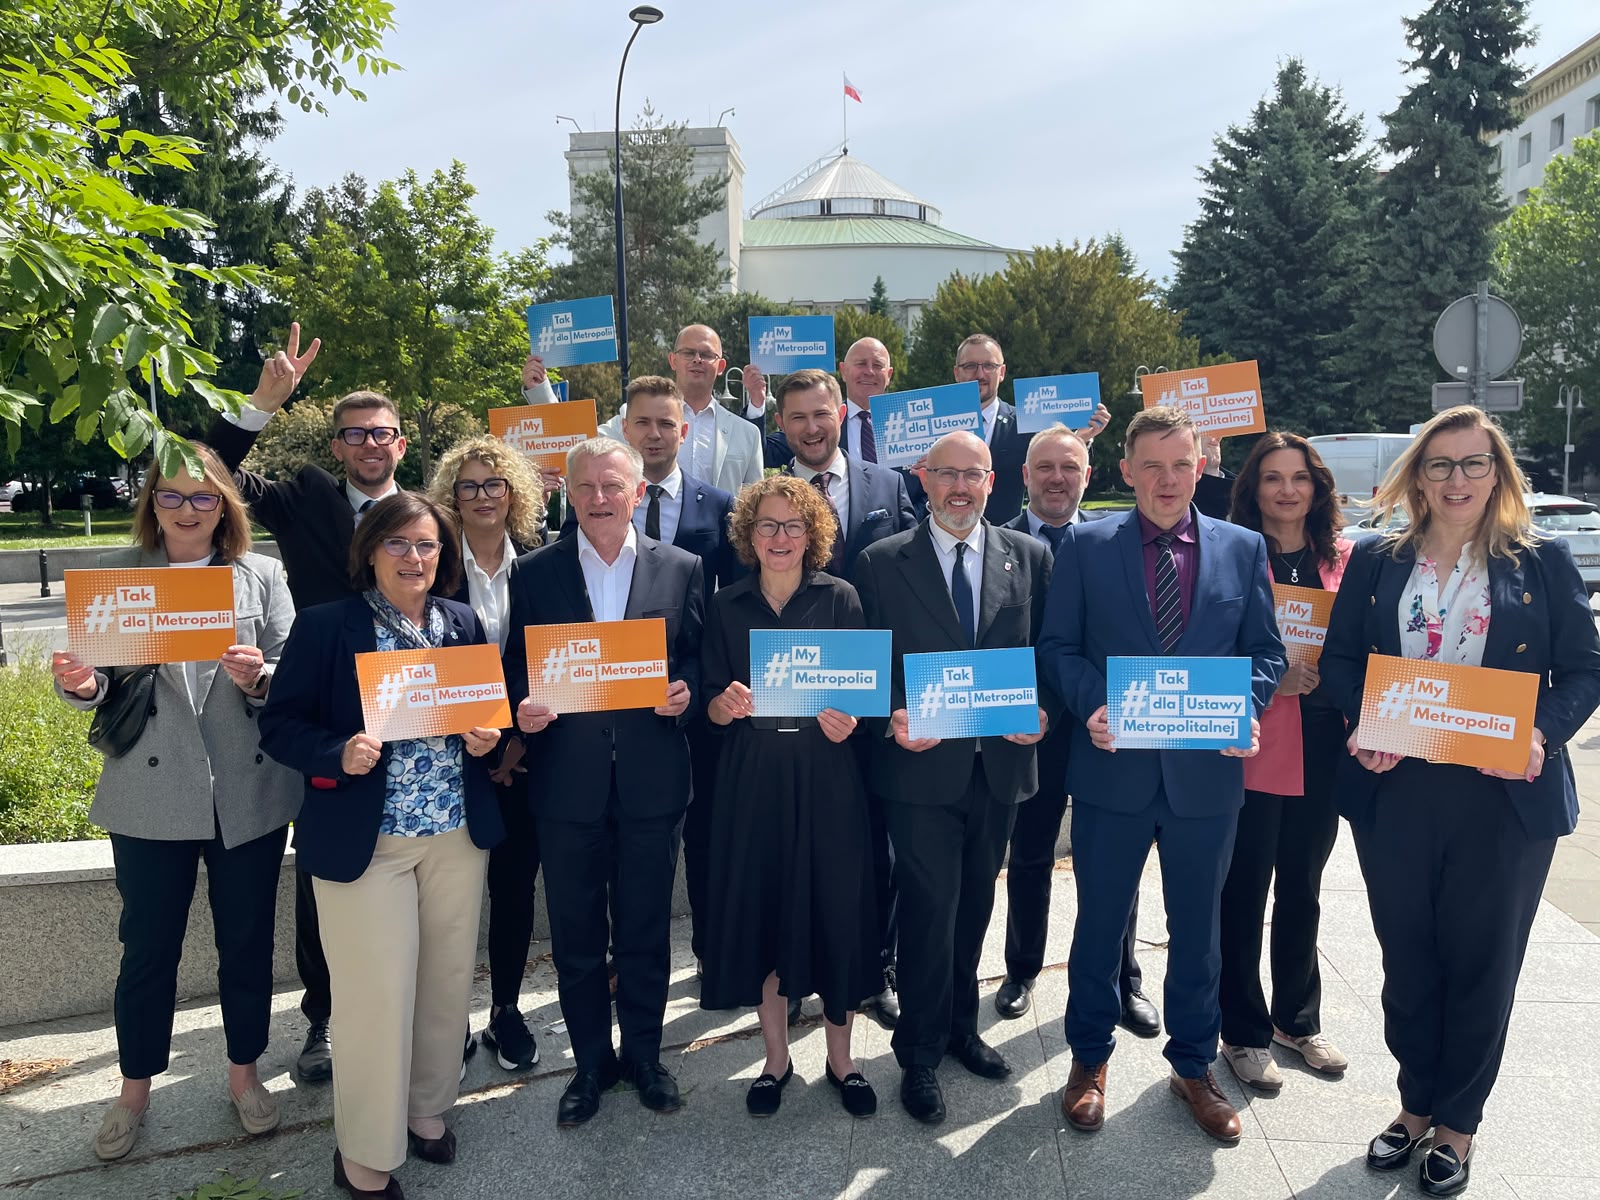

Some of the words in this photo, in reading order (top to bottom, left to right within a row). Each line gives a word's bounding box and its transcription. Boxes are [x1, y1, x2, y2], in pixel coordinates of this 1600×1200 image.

[555, 315, 570, 324] Tak
[557, 333, 568, 341] dla
[574, 328, 612, 340] Metropolii
[777, 328, 790, 337] My
[777, 343, 824, 353] Metropolia
[1042, 388, 1054, 396] My
[1184, 382, 1205, 391] Tak
[910, 401, 930, 412] Tak
[1043, 400, 1089, 410] Metropolia
[1182, 401, 1200, 411] dla
[1209, 395, 1253, 407] Ustawy
[909, 422, 926, 433] dla
[934, 417, 975, 429] Ustawy
[1195, 411, 1251, 427] politalnej
[524, 421, 540, 432] My
[526, 437, 585, 450] Metropoli
[120, 588, 151, 602] Tak
[1289, 603, 1308, 618] My
[122, 616, 146, 628] dla
[156, 612, 230, 627] Metropolii
[1285, 625, 1324, 640] Metro
[571, 641, 597, 654] Tak
[795, 649, 816, 663] My
[405, 667, 432, 679] Tak
[573, 667, 592, 678] dla
[602, 662, 663, 676] Metropolii
[946, 669, 970, 681] Tak
[795, 672, 872, 686] Metropolia
[1159, 672, 1184, 684] Tak
[410, 692, 430, 703] dla
[439, 685, 502, 699] Metropolii
[1418, 680, 1444, 698] My
[948, 694, 966, 704] dla
[974, 690, 1032, 703] Metropolii
[1153, 697, 1175, 710] dla
[1187, 698, 1242, 713] Ustawy
[1414, 706, 1510, 732] Metropolia
[1123, 719, 1235, 736] Metropolitalnej
